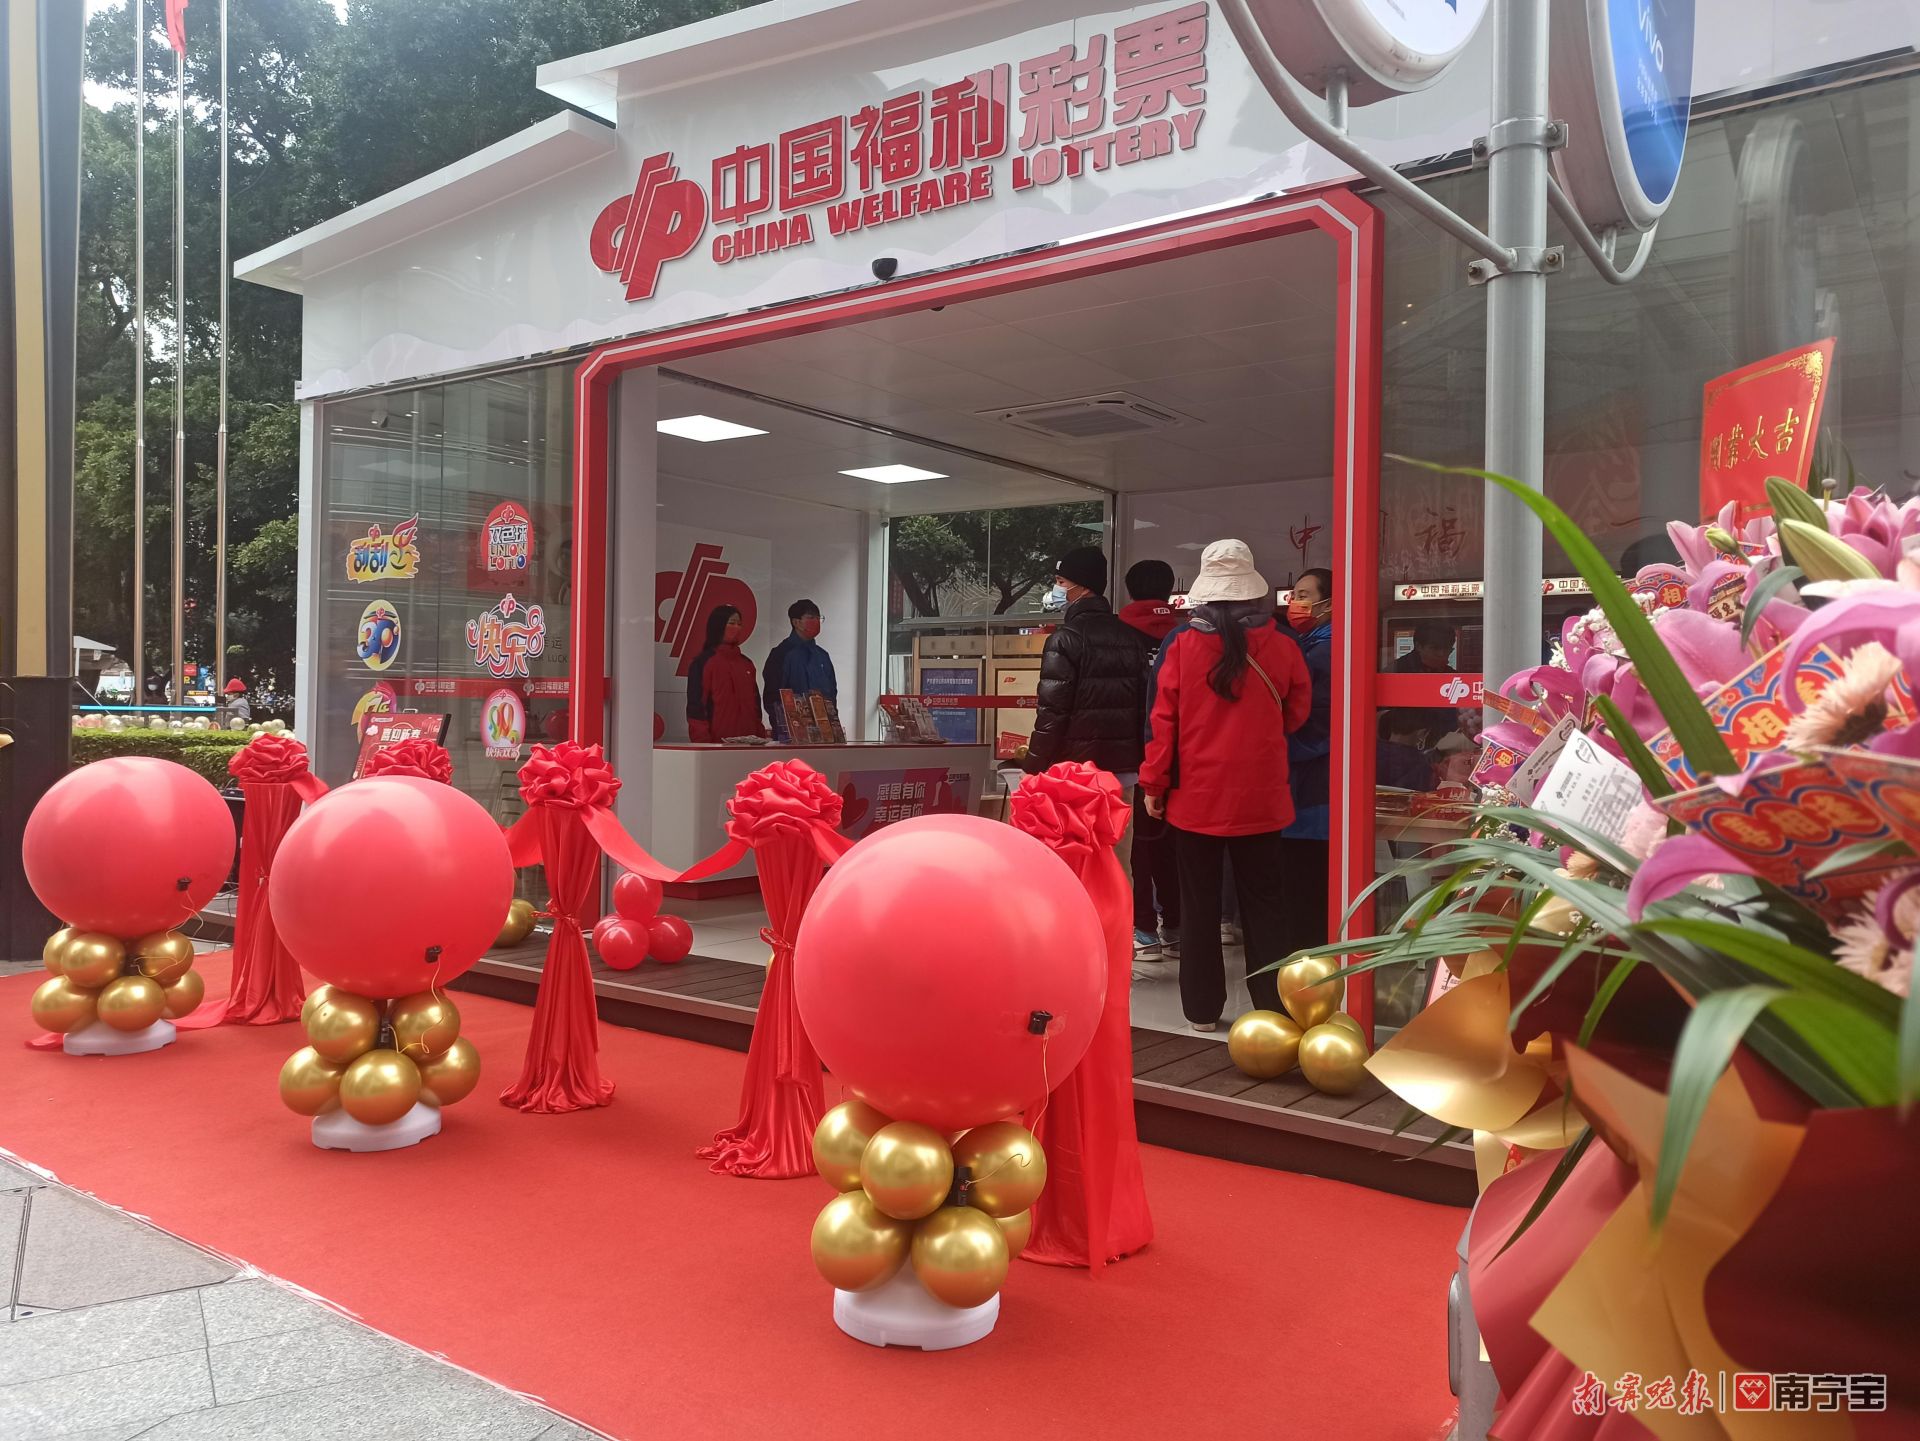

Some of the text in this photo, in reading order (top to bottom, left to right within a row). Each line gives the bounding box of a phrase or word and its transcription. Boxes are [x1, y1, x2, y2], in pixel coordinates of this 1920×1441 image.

[1638, 0, 1664, 73] vivo
[711, 2, 1208, 225] 中国福利彩票
[711, 107, 1206, 266] CHINA WELFARE LOTTERY
[488, 525, 528, 544] 双色球
[489, 543, 528, 557] UNION
[488, 555, 526, 571] LOTTO
[1420, 583, 1480, 594] 中国福利彩票
[877, 781, 927, 801] 感恩有你
[874, 803, 924, 824] 幸运有你
